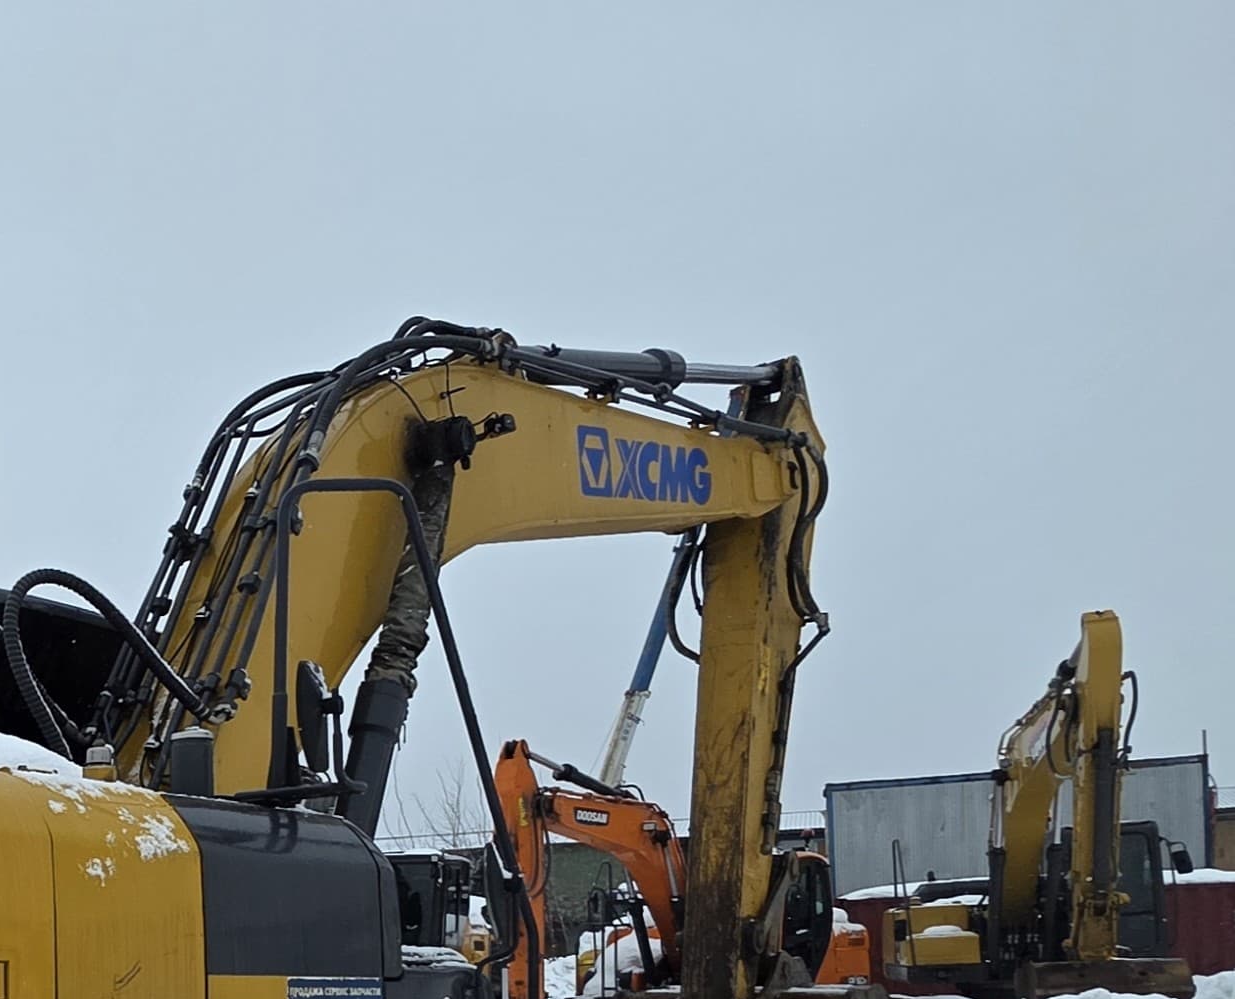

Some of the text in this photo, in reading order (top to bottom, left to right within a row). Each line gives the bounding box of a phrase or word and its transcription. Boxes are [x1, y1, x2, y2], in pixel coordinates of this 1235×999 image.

[614, 439, 712, 505] XCMG
[576, 810, 608, 823] DOOSAN
[289, 986, 381, 998] ПРОДАЖА СЕРВИС ЗАПЧАСТИ
